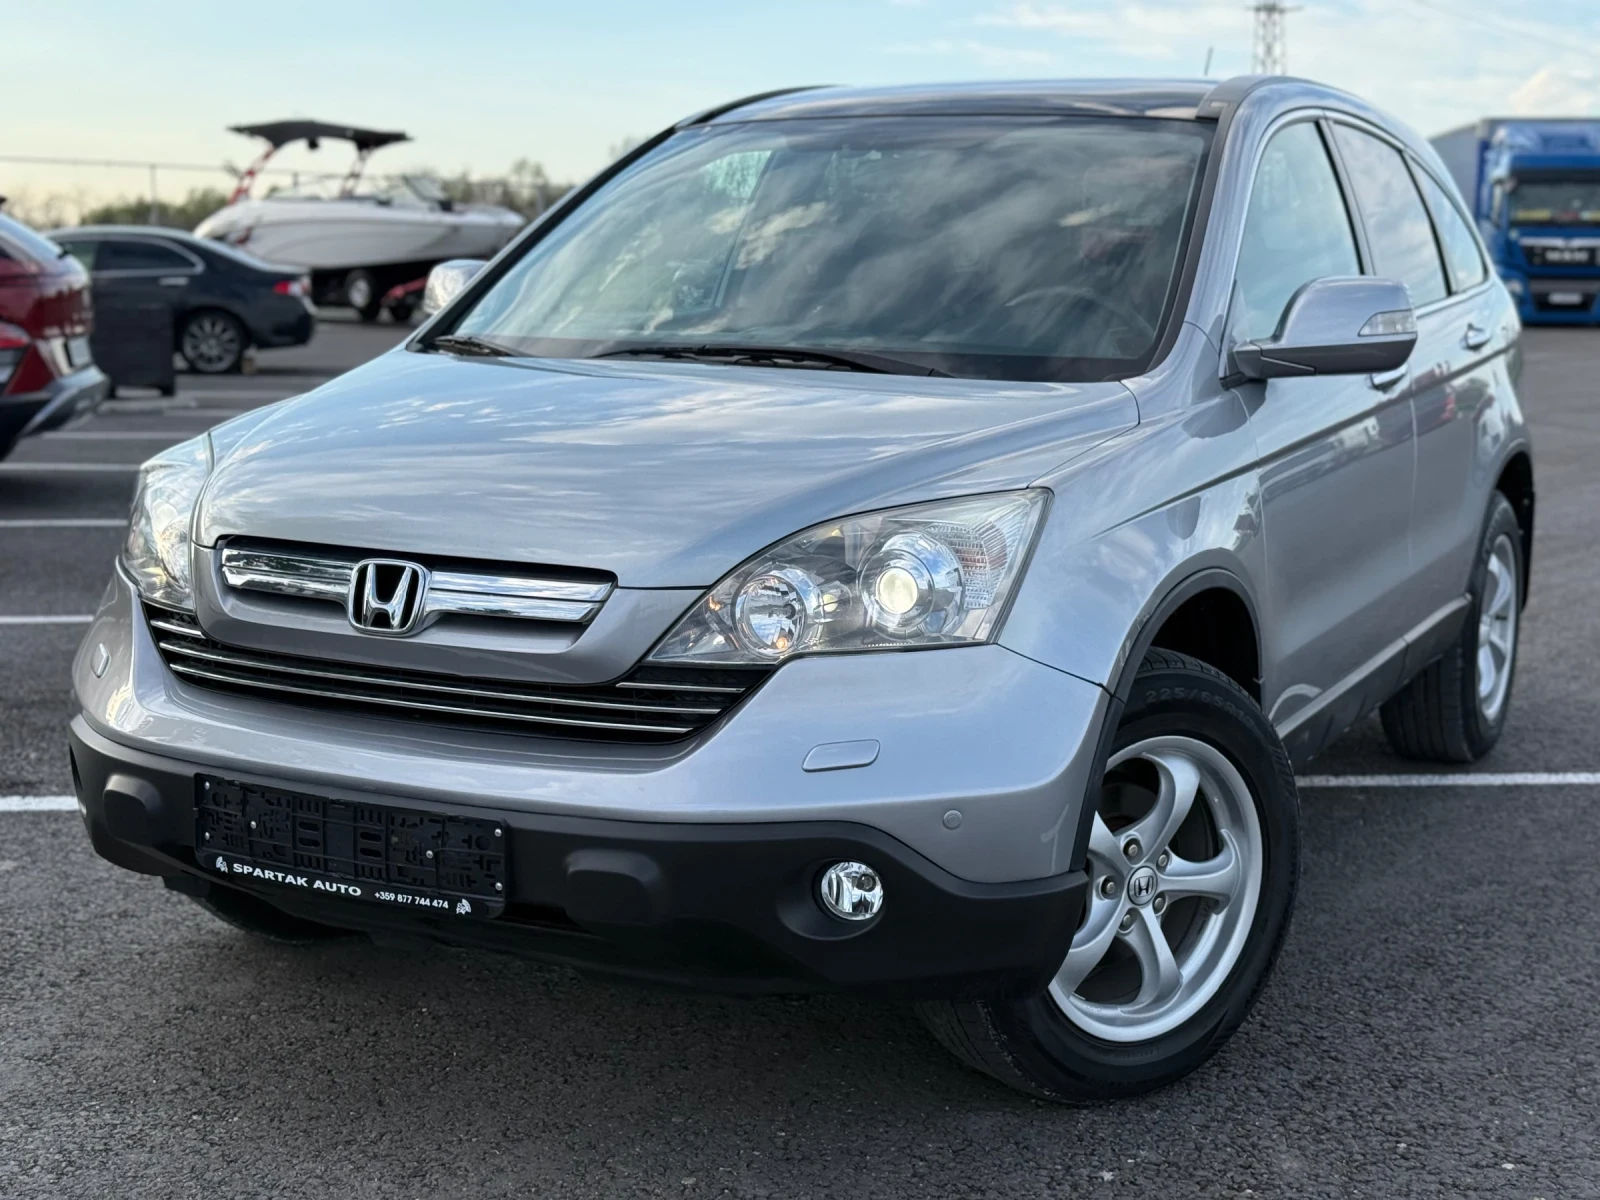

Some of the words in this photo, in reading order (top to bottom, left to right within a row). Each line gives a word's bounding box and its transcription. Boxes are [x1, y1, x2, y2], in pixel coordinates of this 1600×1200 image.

[233, 863, 308, 887] SPARTAK
[313, 880, 361, 896] AUTO
[374, 891, 395, 901] +359
[397, 894, 412, 904] 877
[414, 896, 431, 907] 744
[432, 899, 449, 909] 474
